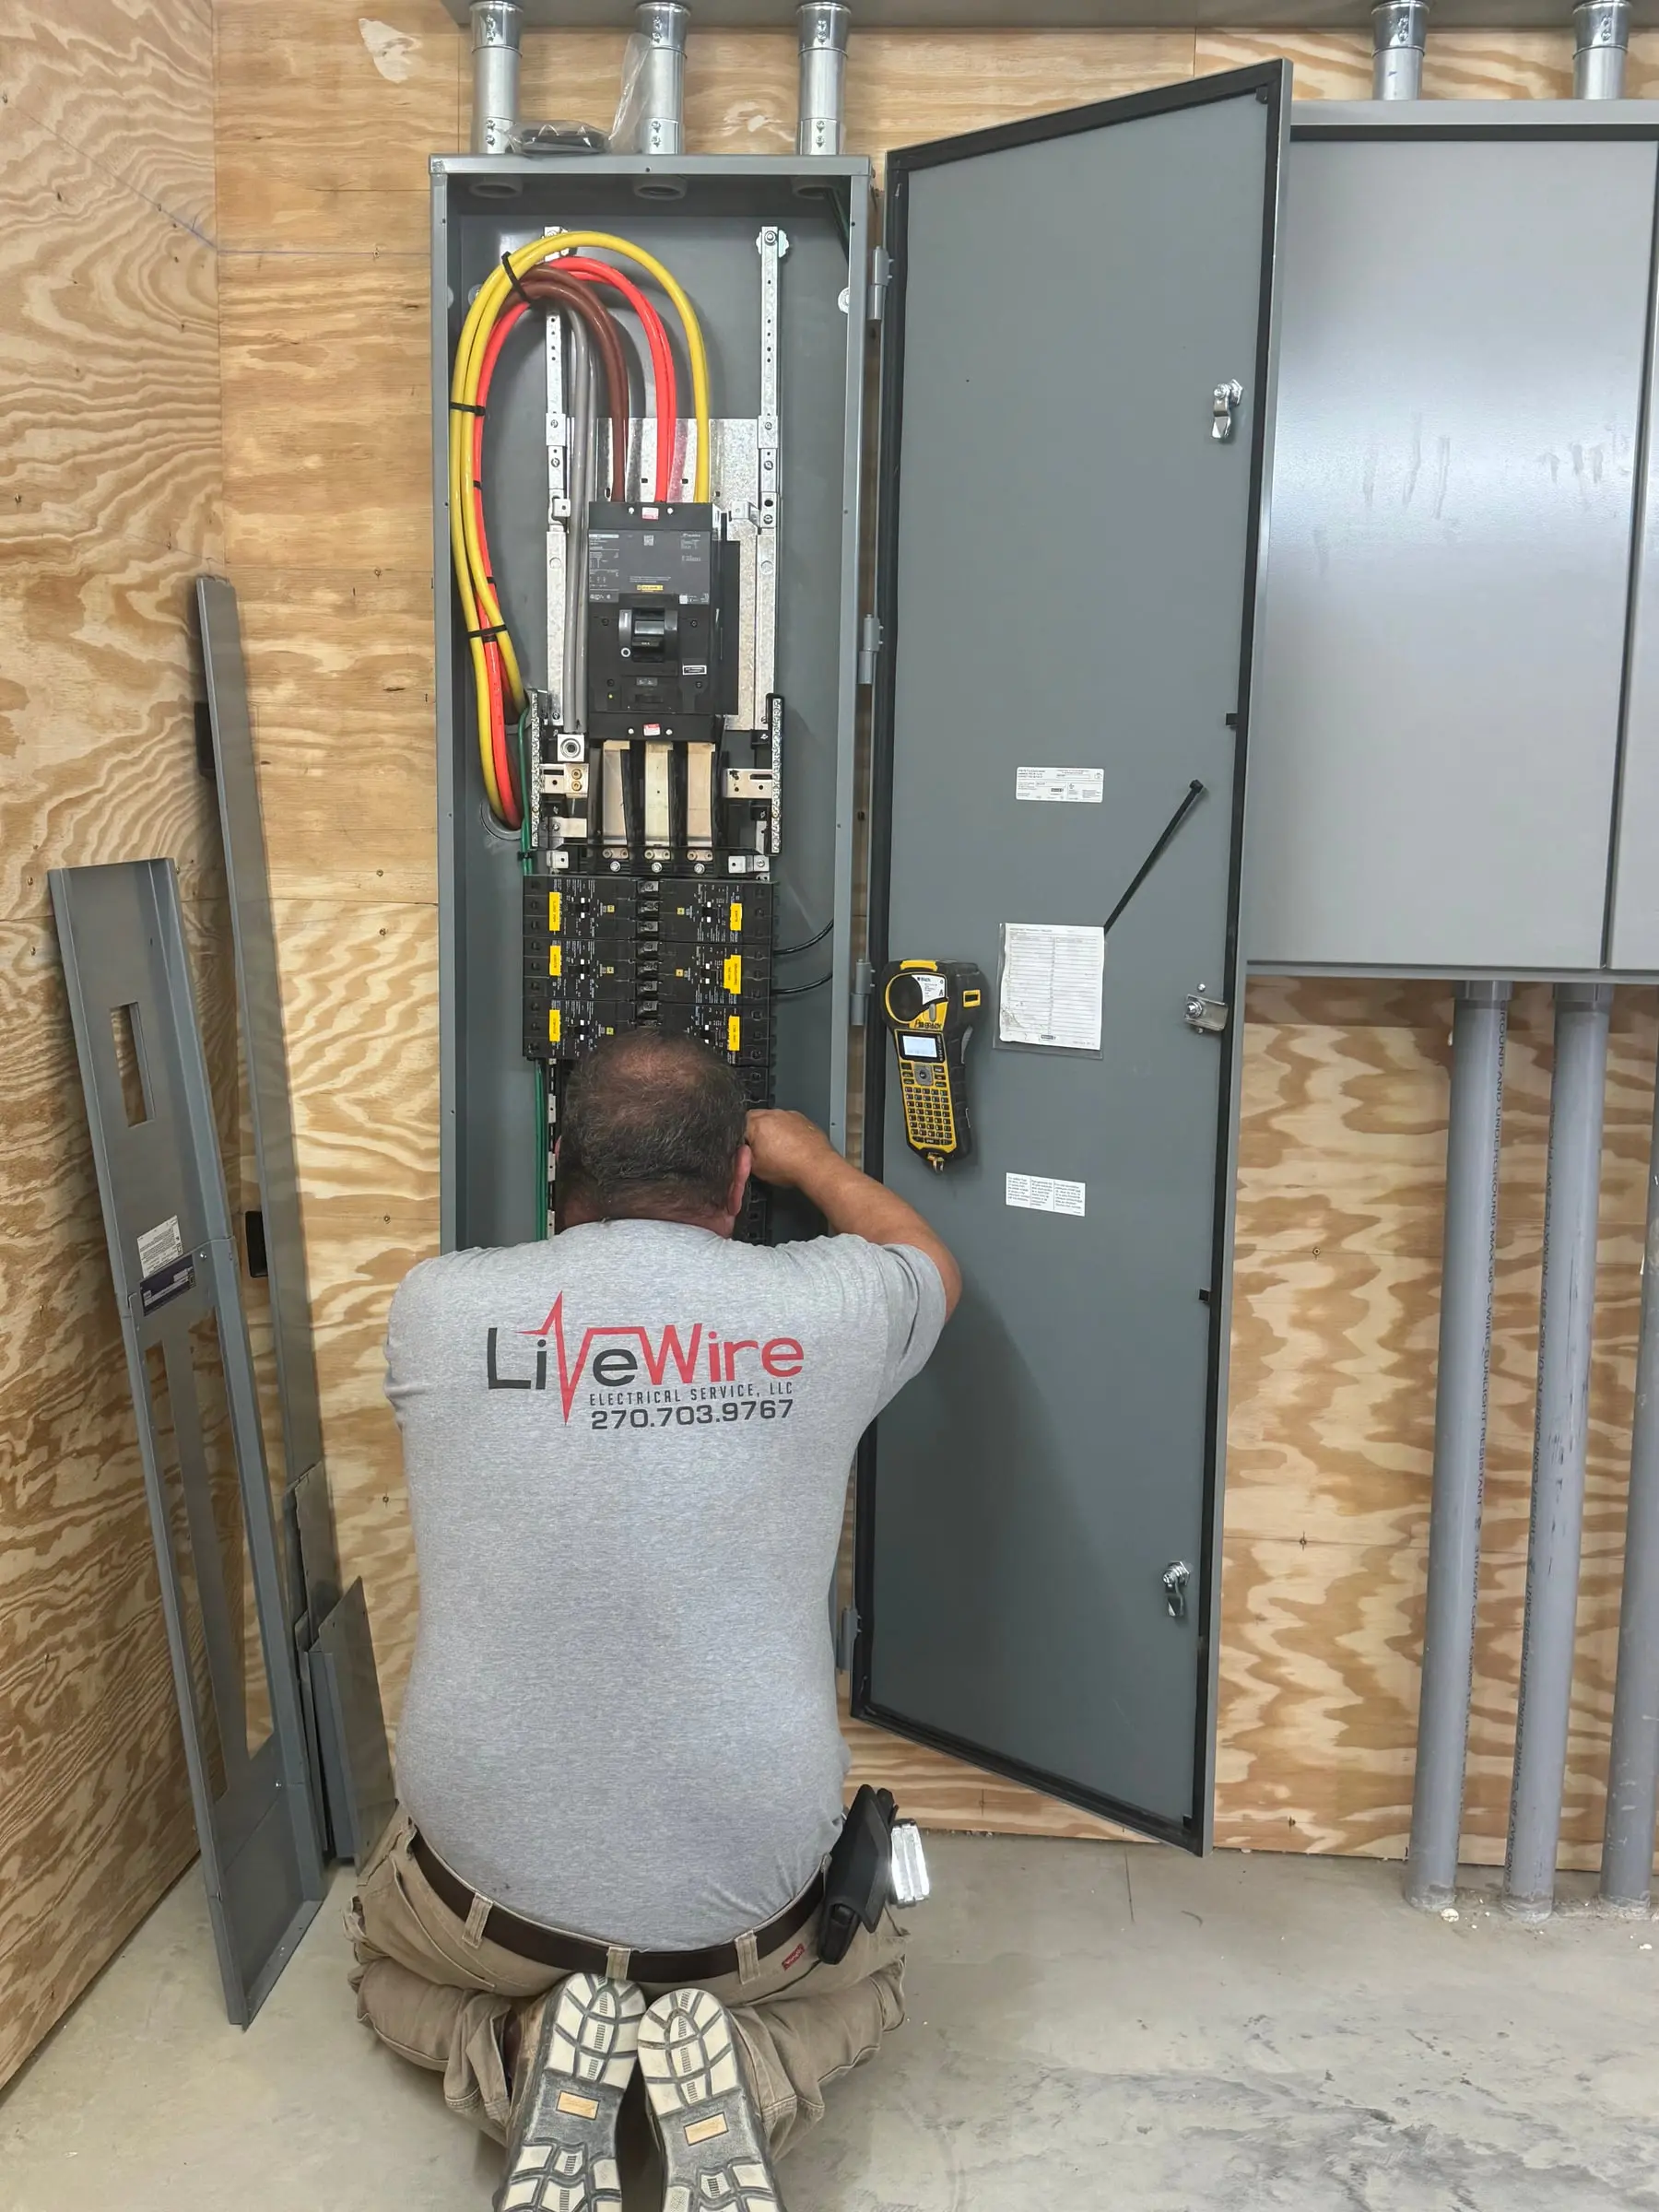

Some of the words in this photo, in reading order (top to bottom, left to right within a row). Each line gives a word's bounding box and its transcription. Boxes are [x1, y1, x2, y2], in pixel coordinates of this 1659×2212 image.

[588, 1387, 681, 1406] ELECTRICAL
[689, 1382, 761, 1402] SERVICE,
[770, 1381, 794, 1395] LLC
[591, 1399, 794, 1430] 270.703.9767
